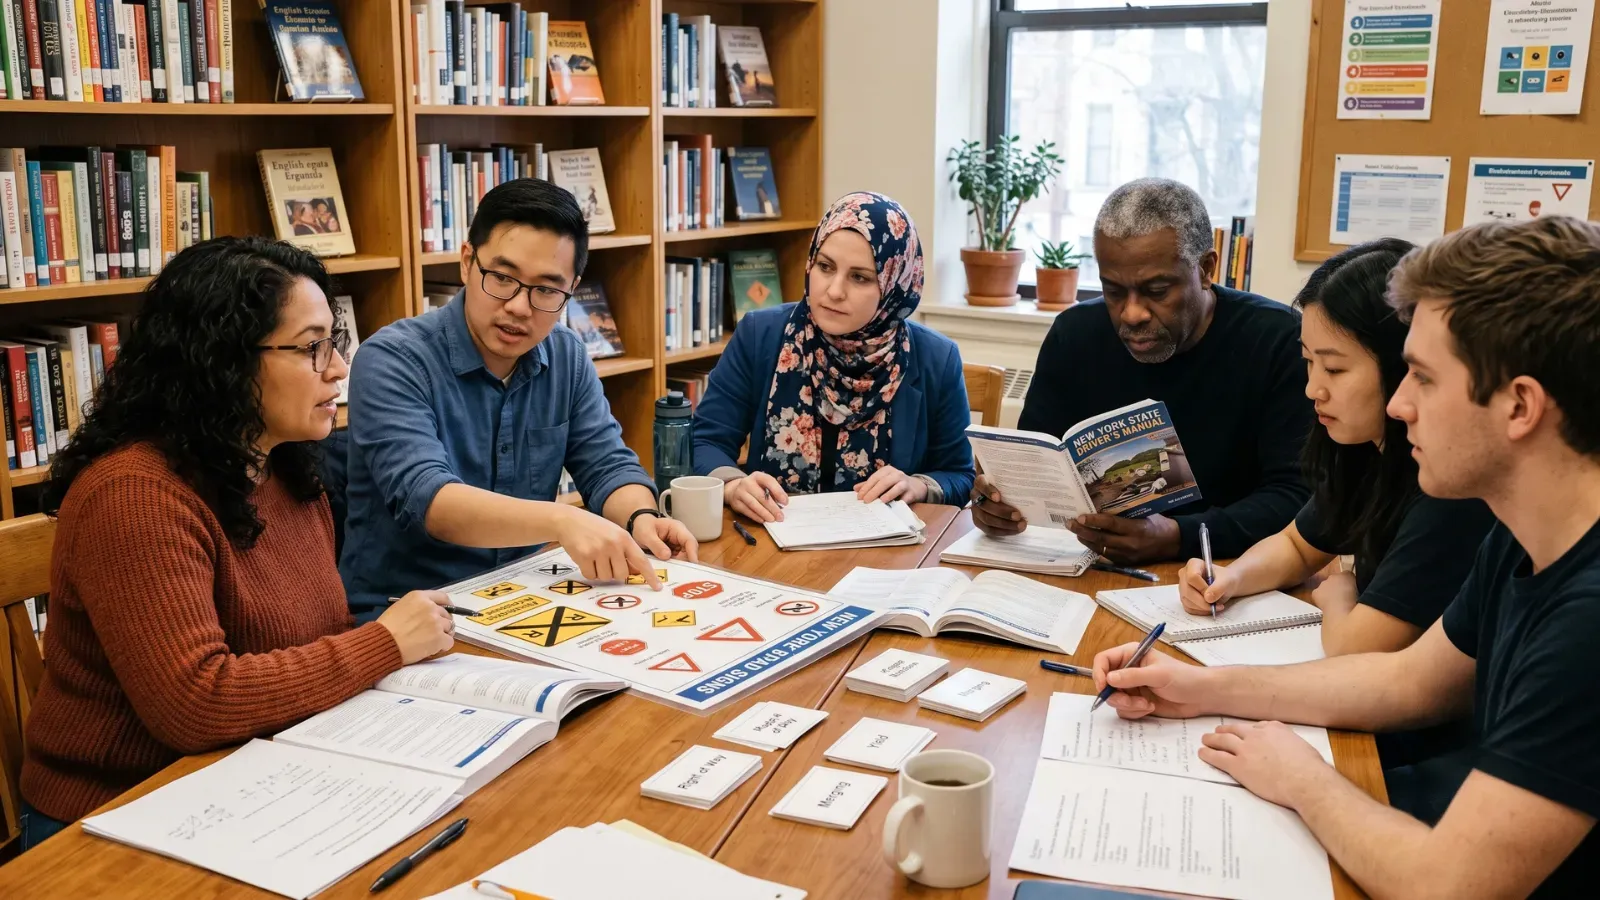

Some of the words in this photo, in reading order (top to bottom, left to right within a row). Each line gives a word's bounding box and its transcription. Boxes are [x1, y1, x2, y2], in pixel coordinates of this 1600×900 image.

[273, 6, 302, 15] English
[1354, 19, 1360, 28] 1
[1352, 34, 1359, 43] 2
[1349, 67, 1357, 76] 4
[272, 160, 305, 171] English
[1073, 430, 1096, 449] NEW
[1097, 418, 1128, 436] YORK
[1127, 408, 1161, 426] STATE
[1076, 430, 1121, 457] DRIVER'S
[1122, 417, 1166, 437] MANUAL
[682, 580, 718, 599] STOP
[564, 613, 586, 621] R
[821, 611, 859, 632] NEW
[521, 629, 544, 639] R
[697, 668, 749, 695] SIGNS
[817, 781, 852, 808] Merging
